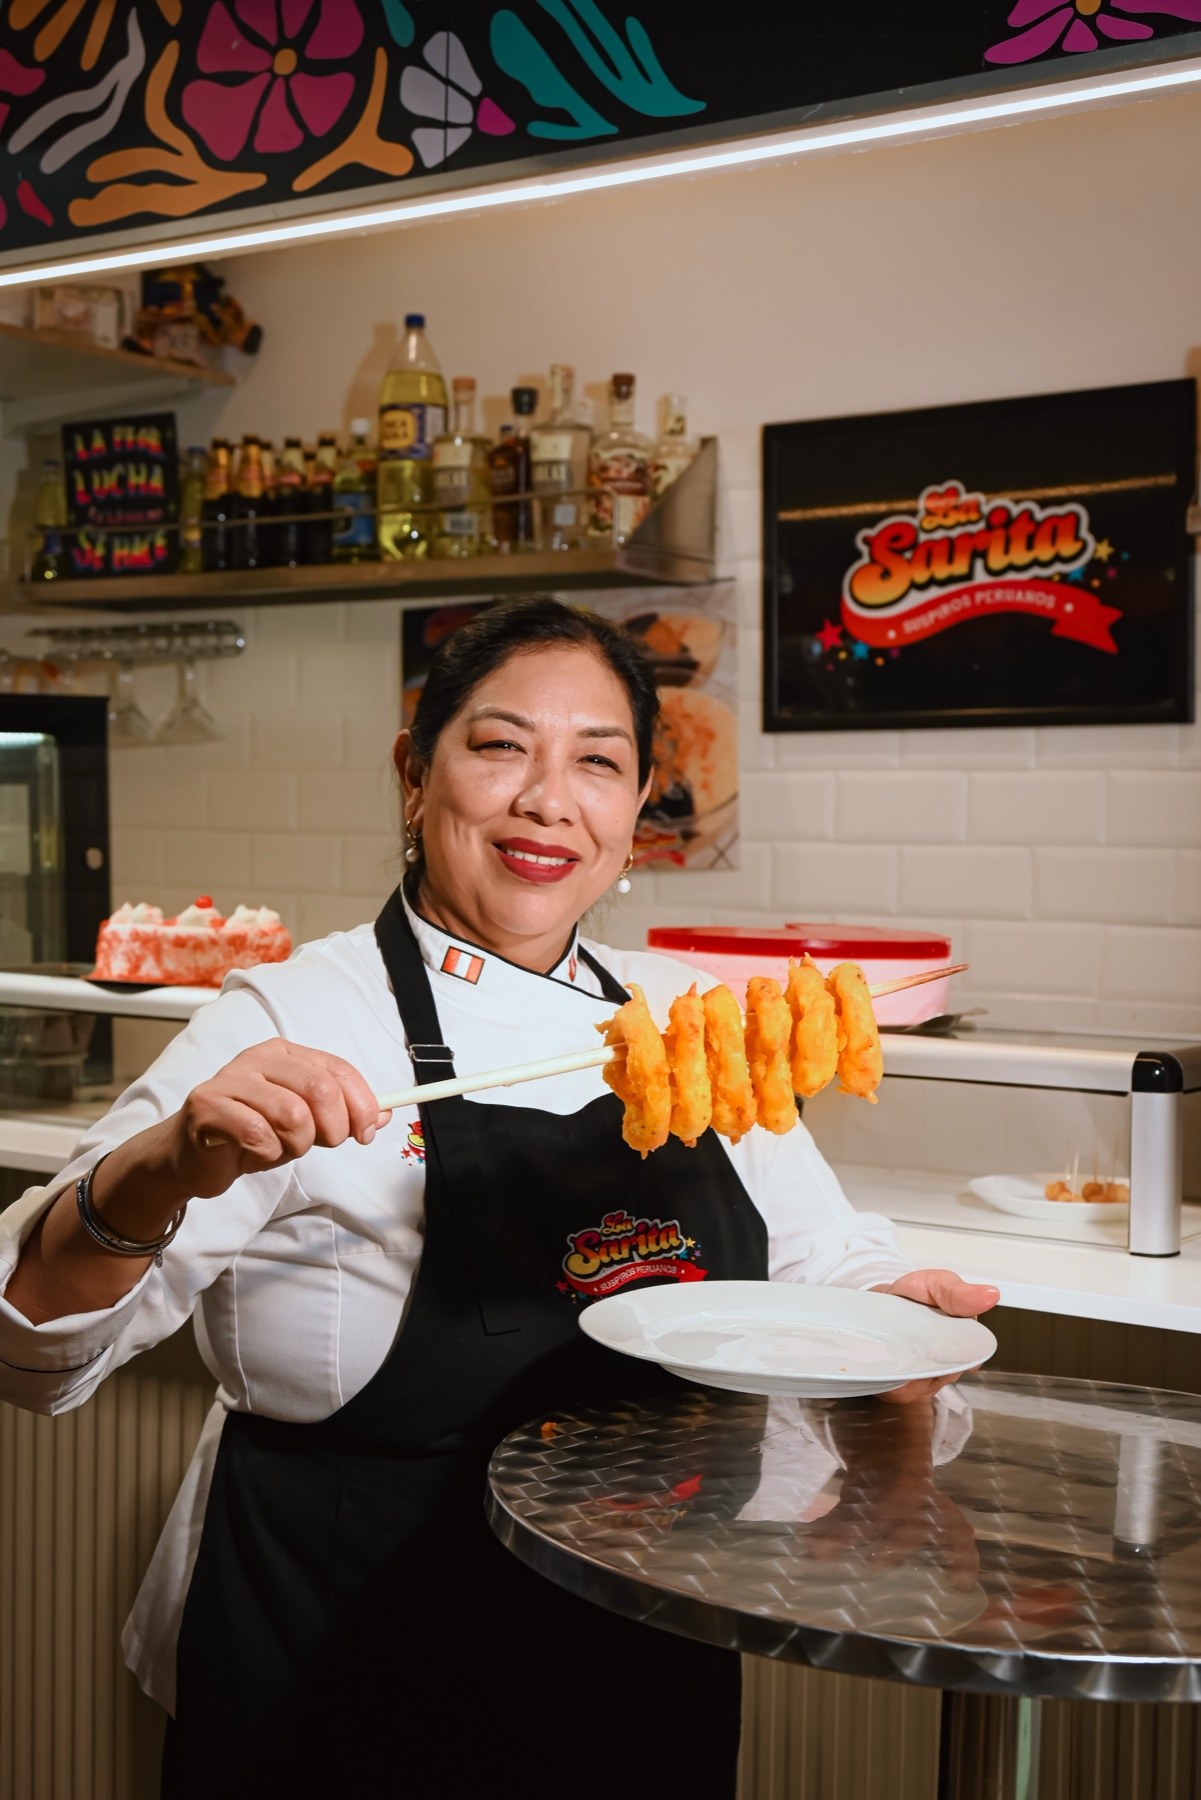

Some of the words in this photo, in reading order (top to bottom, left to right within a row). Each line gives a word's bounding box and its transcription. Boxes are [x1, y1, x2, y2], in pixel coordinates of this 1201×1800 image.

[74, 429, 107, 460] LA
[73, 462, 165, 505] LUCHA
[920, 485, 982, 531] La
[850, 506, 1084, 607] Sarita
[903, 593, 972, 635] SUSPIROS
[973, 587, 1056, 610] PERUANOS
[602, 1211, 634, 1234] La
[567, 1222, 681, 1276] Sarita
[600, 1267, 636, 1291] SUSPIROS
[636, 1265, 678, 1274] PERUANOS
